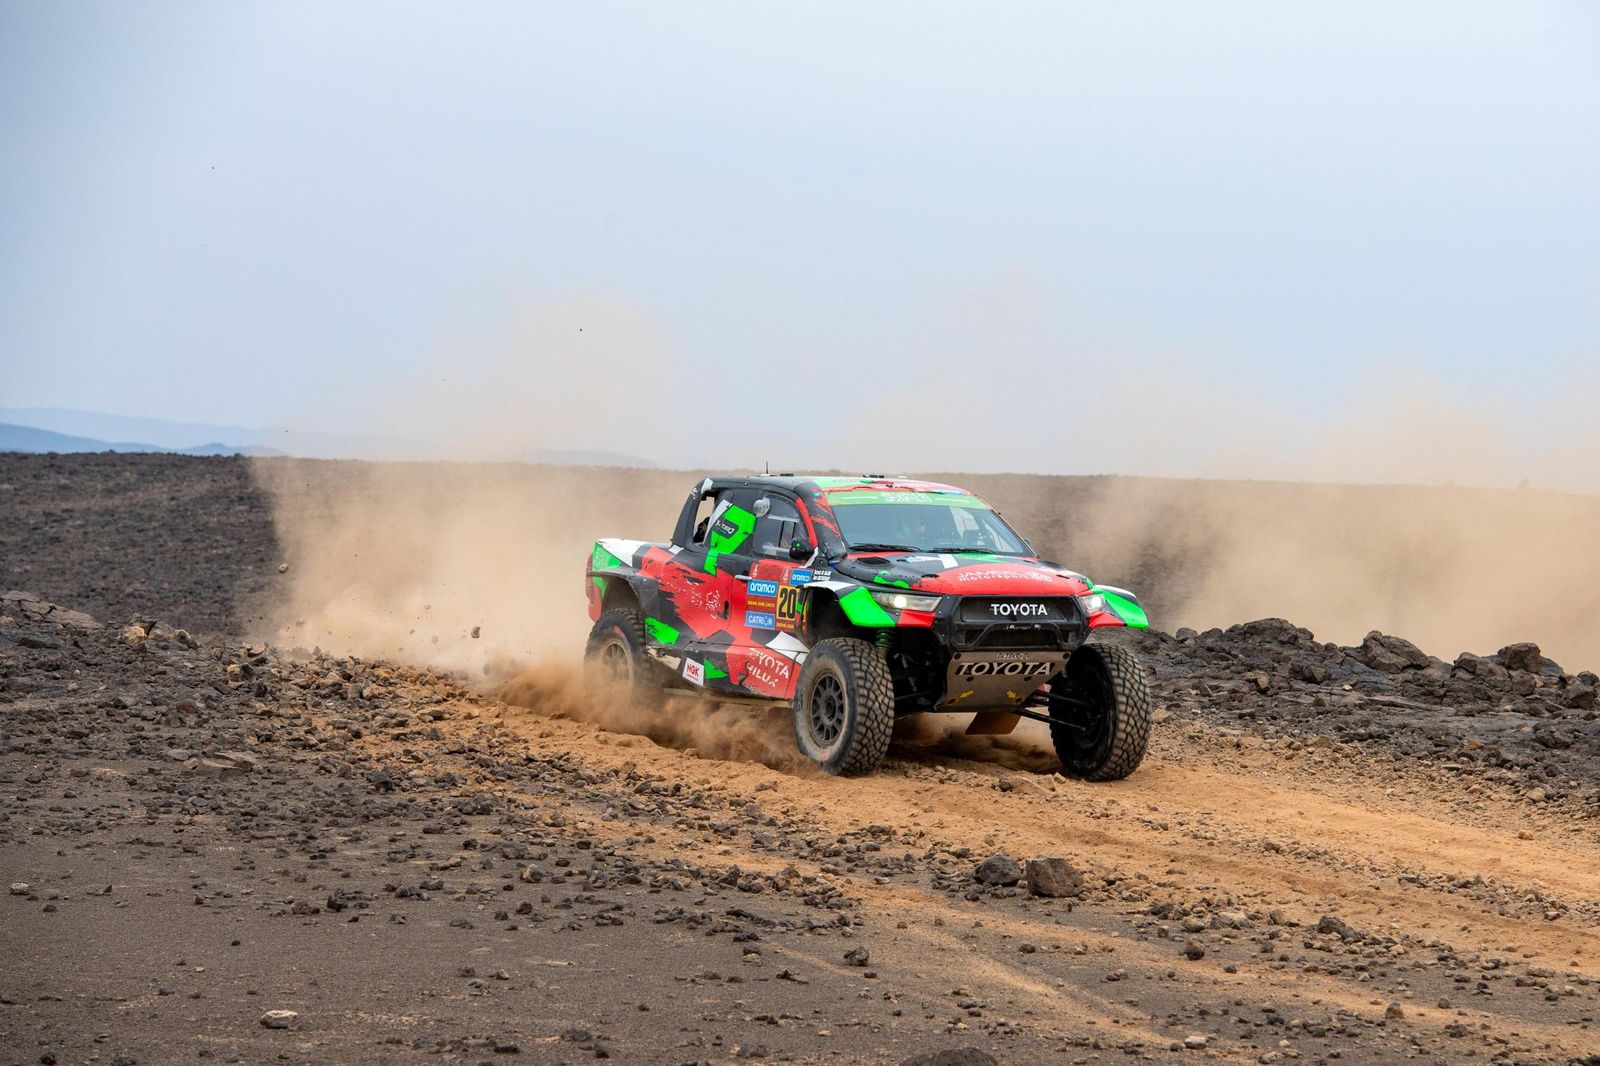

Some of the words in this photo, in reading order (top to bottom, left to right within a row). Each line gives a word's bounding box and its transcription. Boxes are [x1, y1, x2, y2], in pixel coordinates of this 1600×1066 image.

[750, 582, 776, 594] aramco
[778, 587, 797, 619] 20
[990, 603, 1048, 616] TOYOTA
[686, 663, 700, 677] NGK
[748, 647, 790, 680] TYOTA
[958, 662, 1051, 676] TOYOTA
